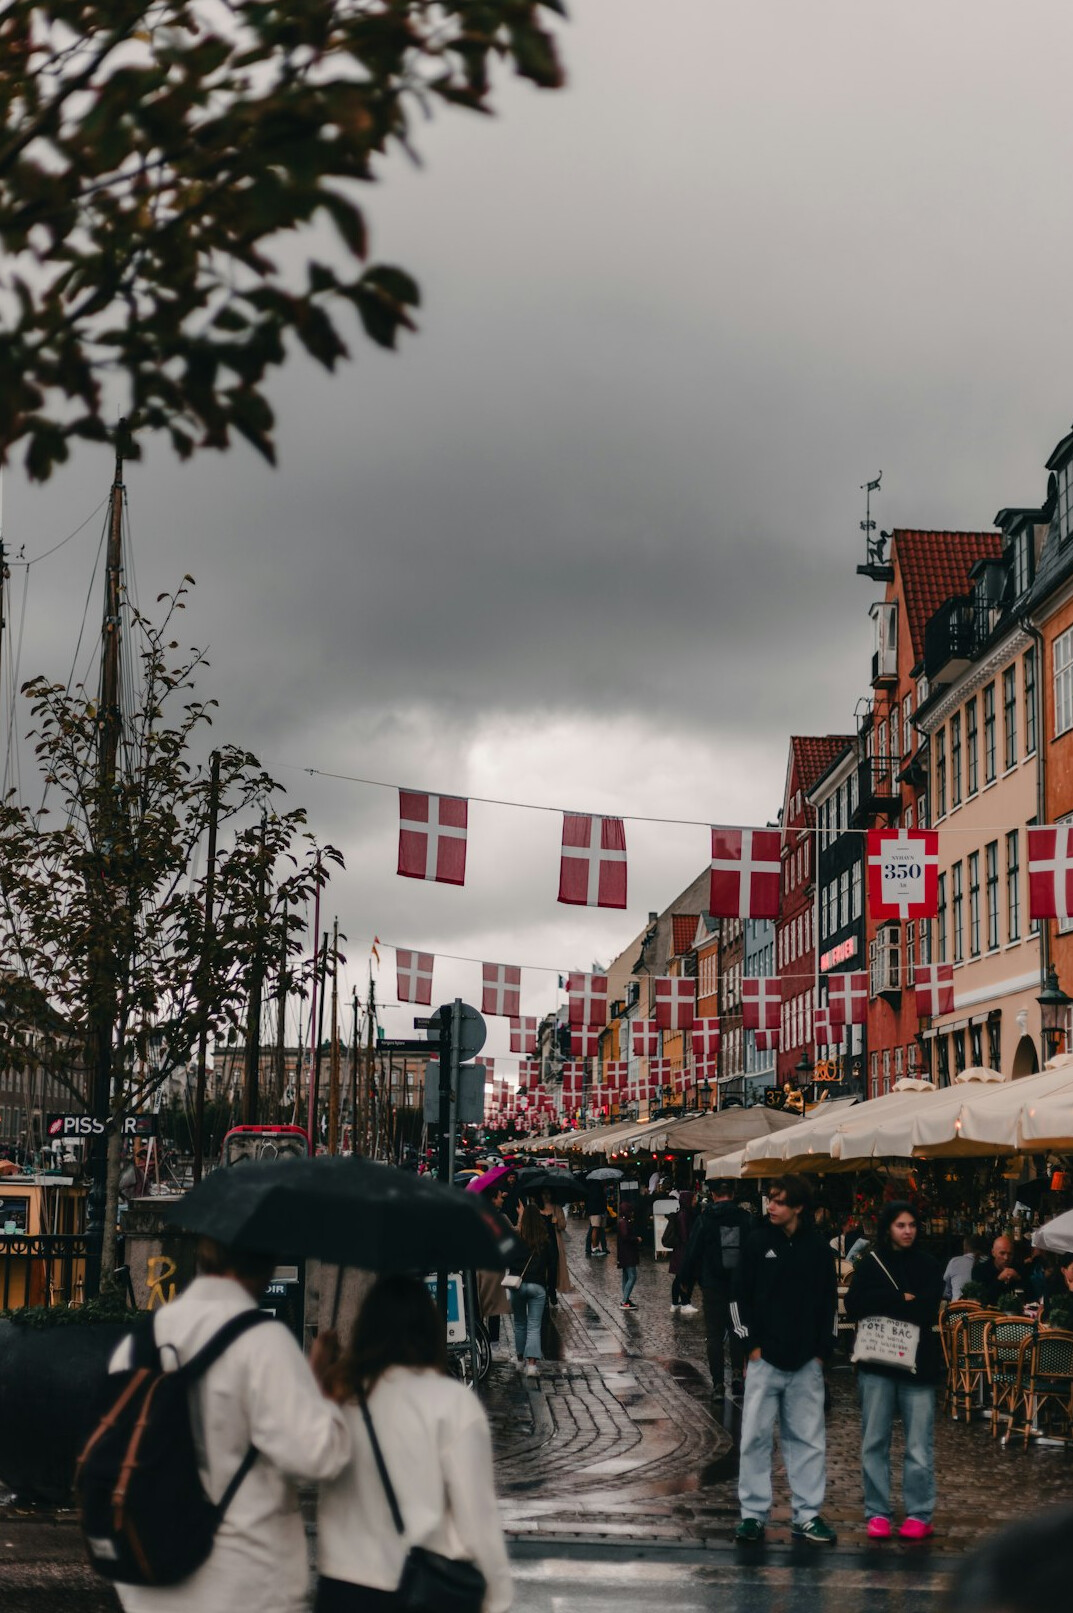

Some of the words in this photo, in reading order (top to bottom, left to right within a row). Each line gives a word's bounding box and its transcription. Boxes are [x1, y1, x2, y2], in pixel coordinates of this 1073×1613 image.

[885, 864, 921, 879] 350
[766, 1090, 782, 1106] 37
[892, 1327, 912, 1339] BAG
